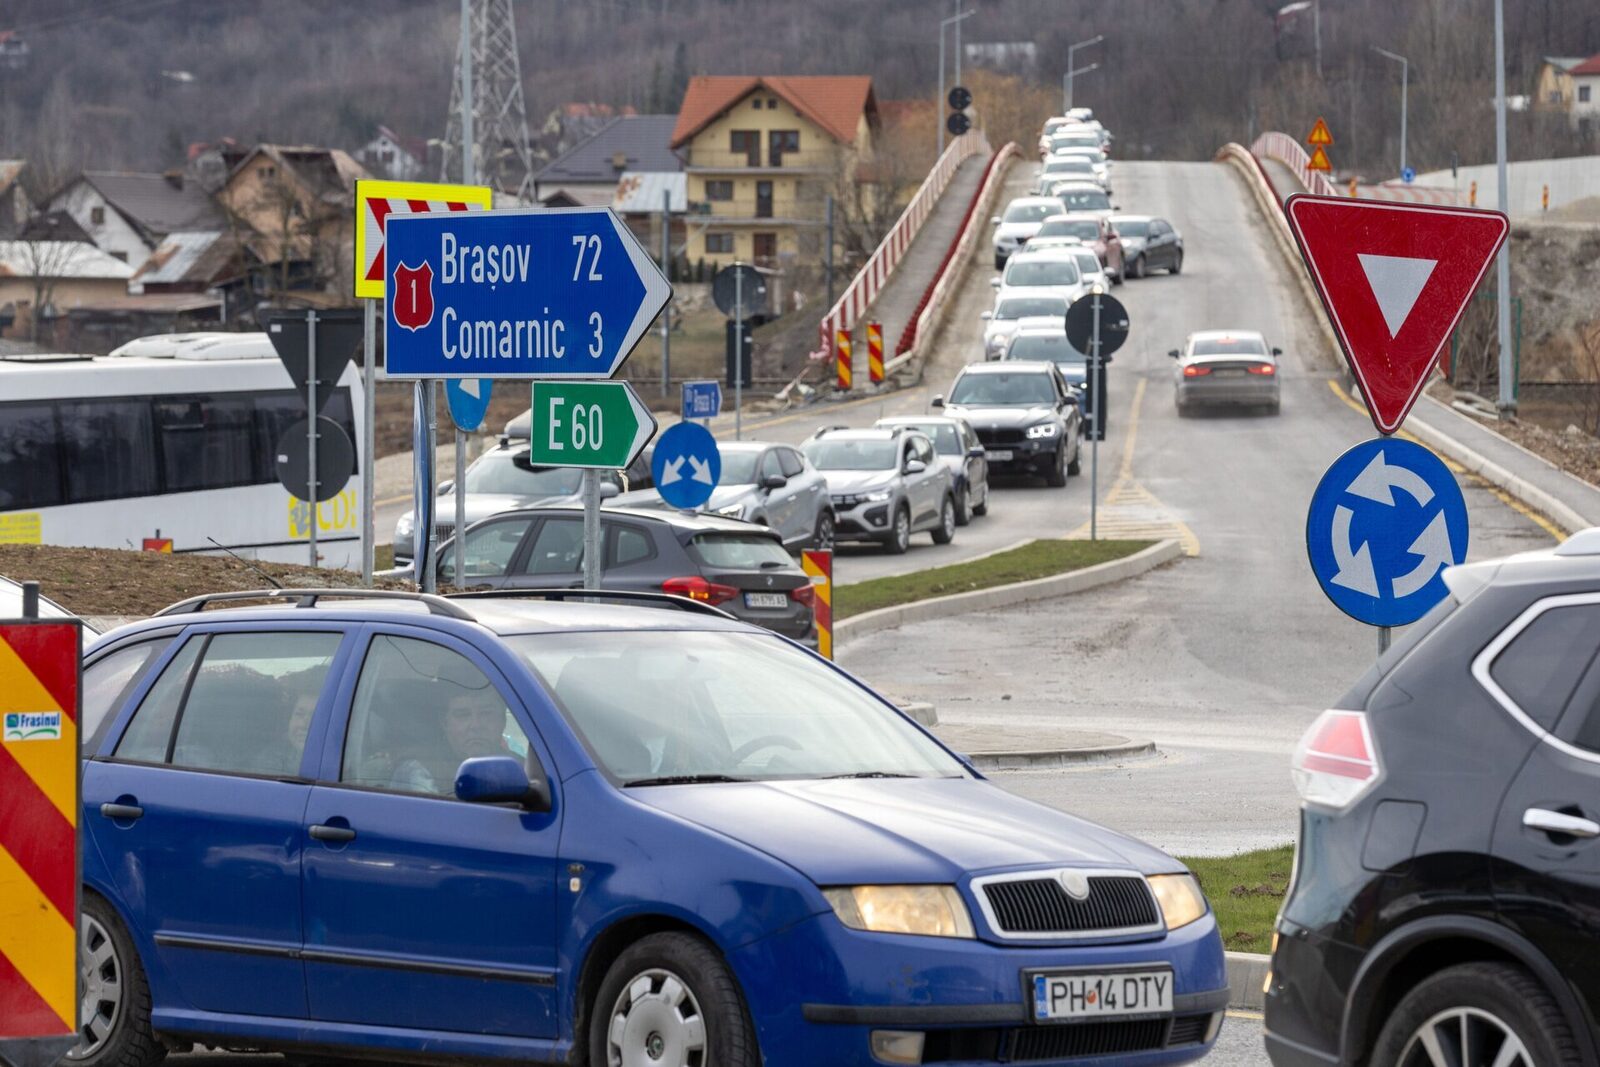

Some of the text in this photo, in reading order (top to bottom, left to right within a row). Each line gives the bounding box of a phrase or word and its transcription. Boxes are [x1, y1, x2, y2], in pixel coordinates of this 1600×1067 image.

[441, 232, 603, 291] Brașov 72
[410, 279, 417, 314] 1
[441, 306, 603, 359] Comarnic 3
[549, 397, 603, 450] E 60
[20, 712, 60, 727] Frasinul
[1051, 979, 1086, 1013] PH
[1094, 978, 1117, 1010] 14
[1123, 975, 1167, 1010] DTY
